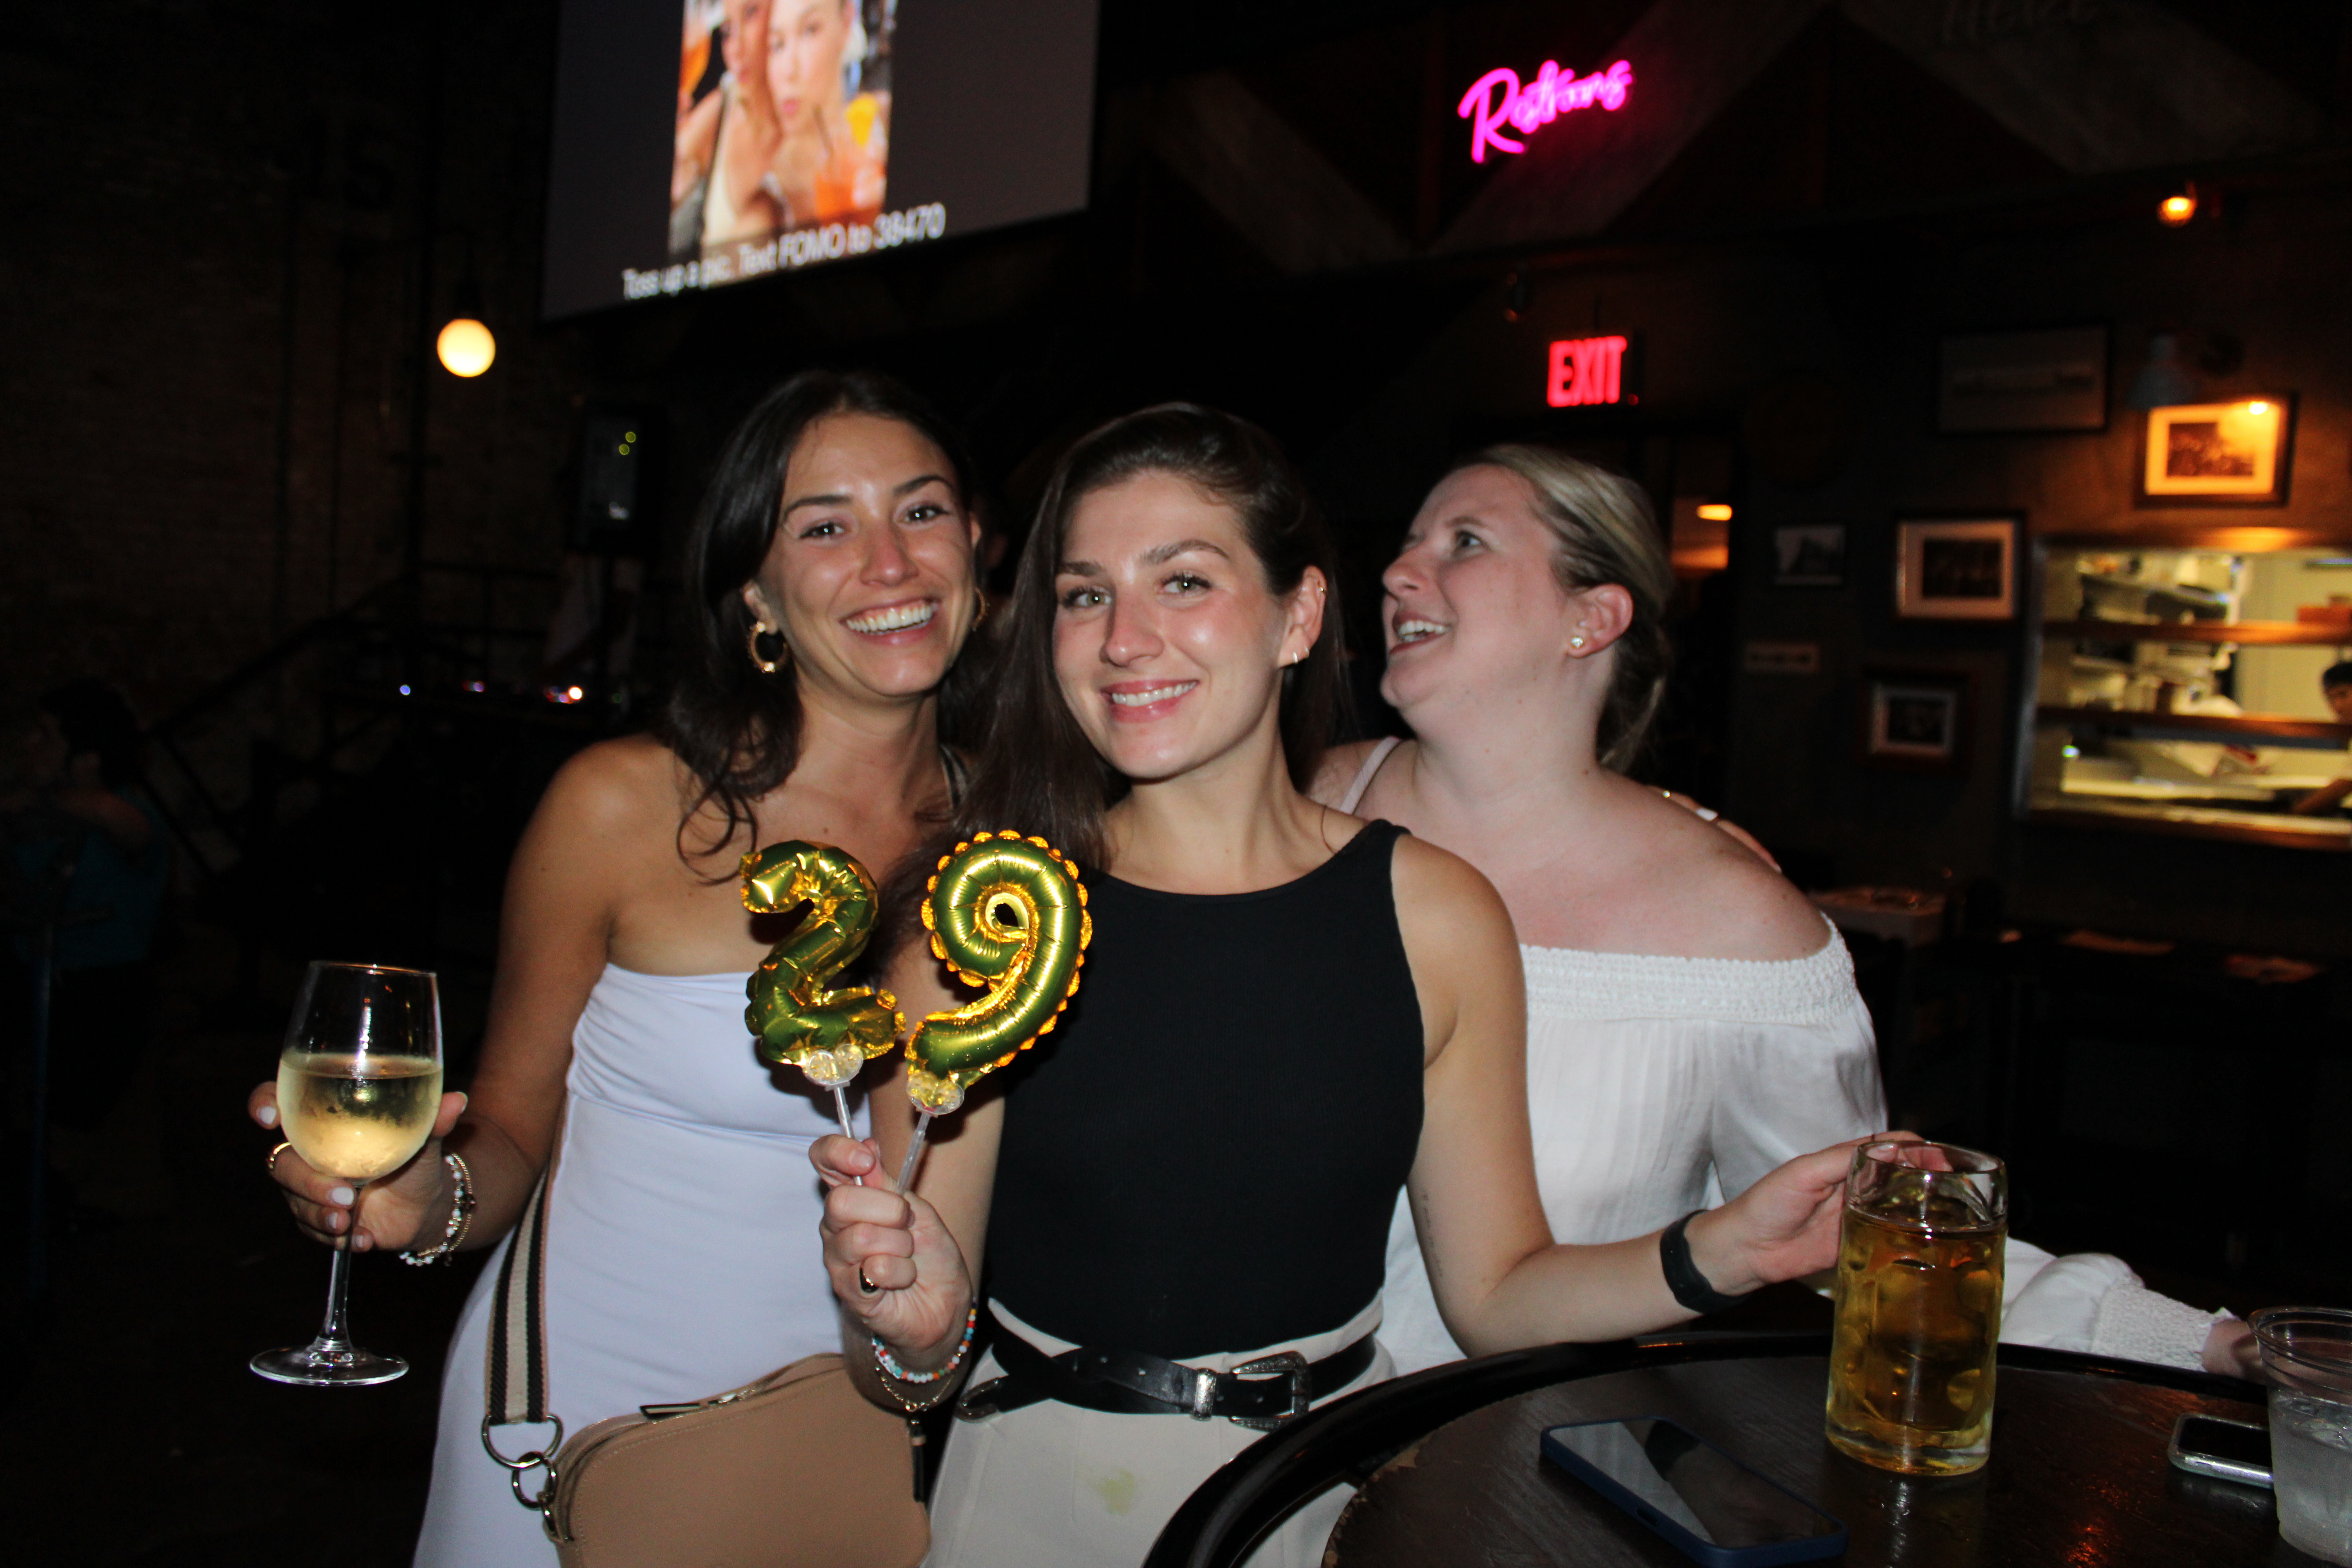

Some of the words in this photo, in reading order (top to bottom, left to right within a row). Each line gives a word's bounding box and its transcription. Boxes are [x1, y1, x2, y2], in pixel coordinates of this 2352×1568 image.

[622, 268, 660, 299] Toss
[661, 264, 686, 296] up
[686, 261, 700, 287] a
[739, 241, 777, 275] Text
[778, 223, 846, 268] FOMO
[848, 222, 872, 254] to
[874, 202, 946, 249] 38470
[1547, 336, 1627, 407] EXIT
